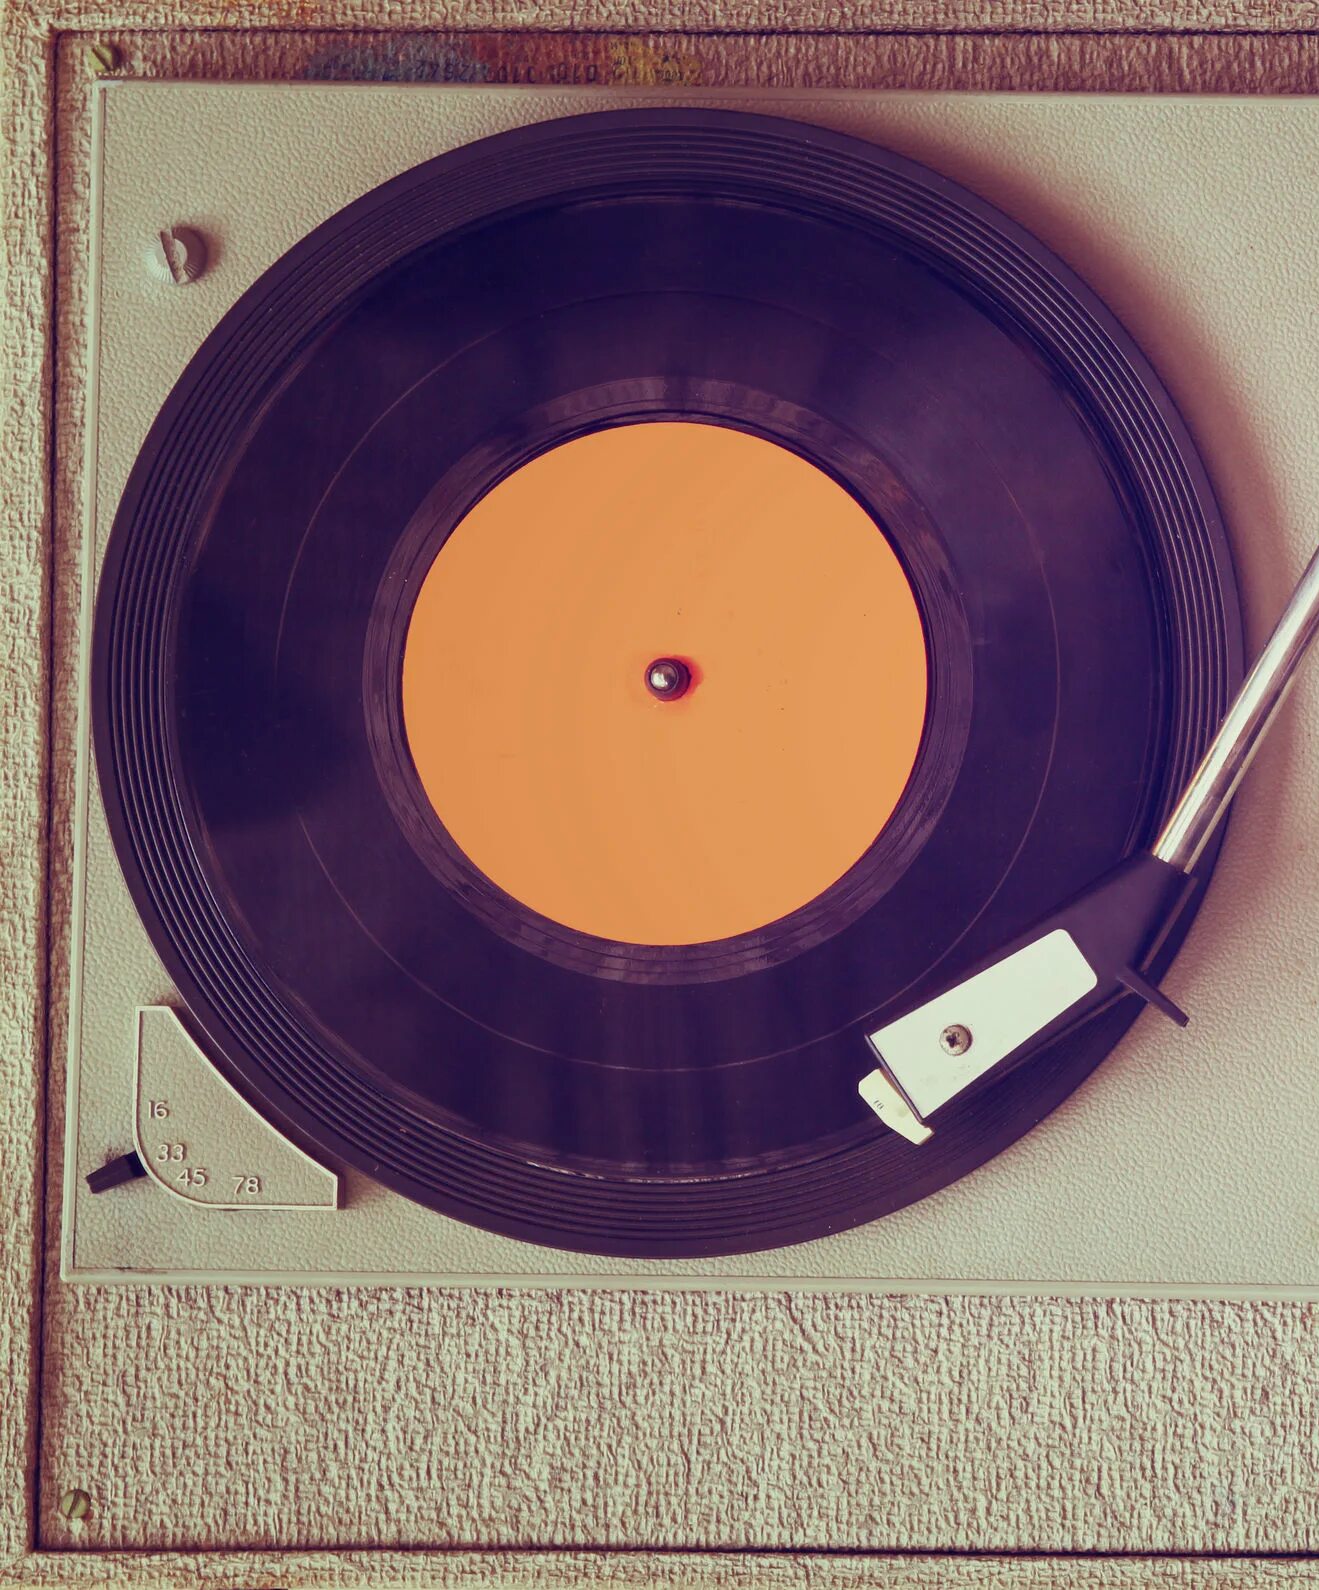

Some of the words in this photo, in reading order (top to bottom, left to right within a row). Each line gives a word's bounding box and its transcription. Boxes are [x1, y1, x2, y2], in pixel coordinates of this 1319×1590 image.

[148, 1100, 169, 1119] 16
[156, 1143, 185, 1162] 33
[176, 1168, 207, 1187] 45
[231, 1176, 261, 1195] 78
